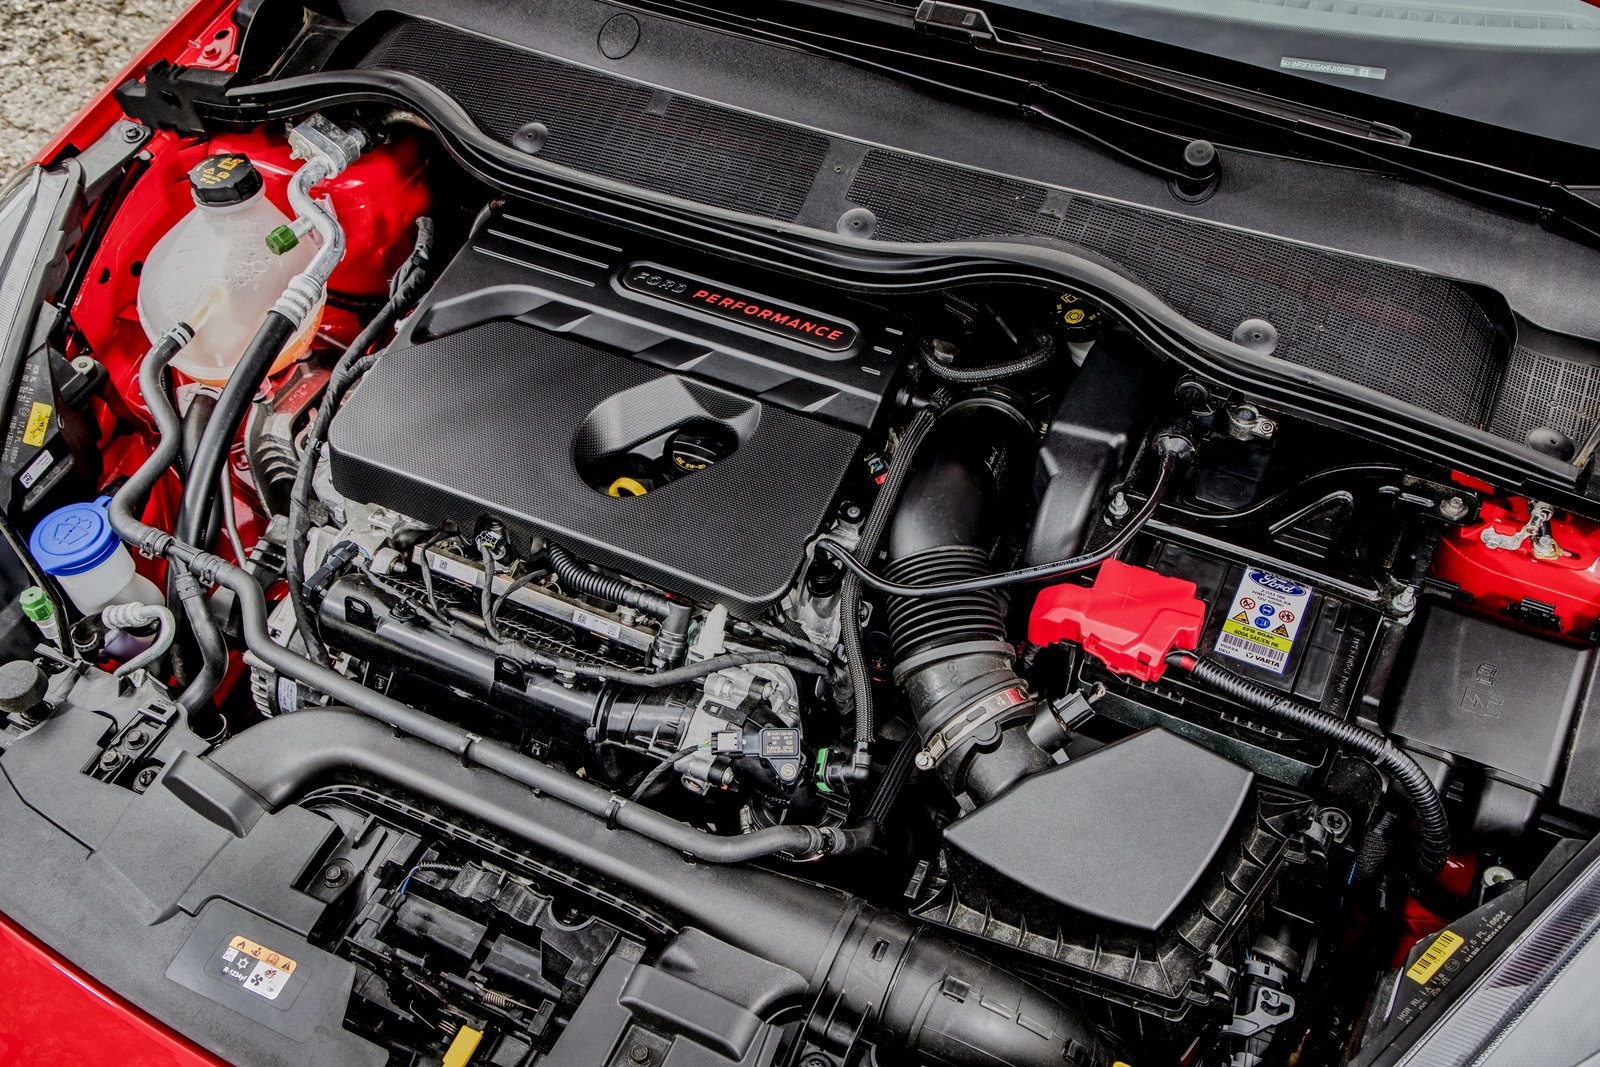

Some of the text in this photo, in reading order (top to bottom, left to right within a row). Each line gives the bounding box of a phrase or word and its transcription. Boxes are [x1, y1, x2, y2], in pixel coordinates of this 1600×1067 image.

[634, 272, 844, 341] FORD PERFORMANCE
[1258, 574, 1296, 594] Ford
[1254, 655, 1280, 667] VARTA
[223, 967, 248, 981] R-1234yf
[1397, 1007, 1412, 1021] HCR
[1411, 998, 1422, 1006] RL
[1476, 930, 1487, 939] PL
